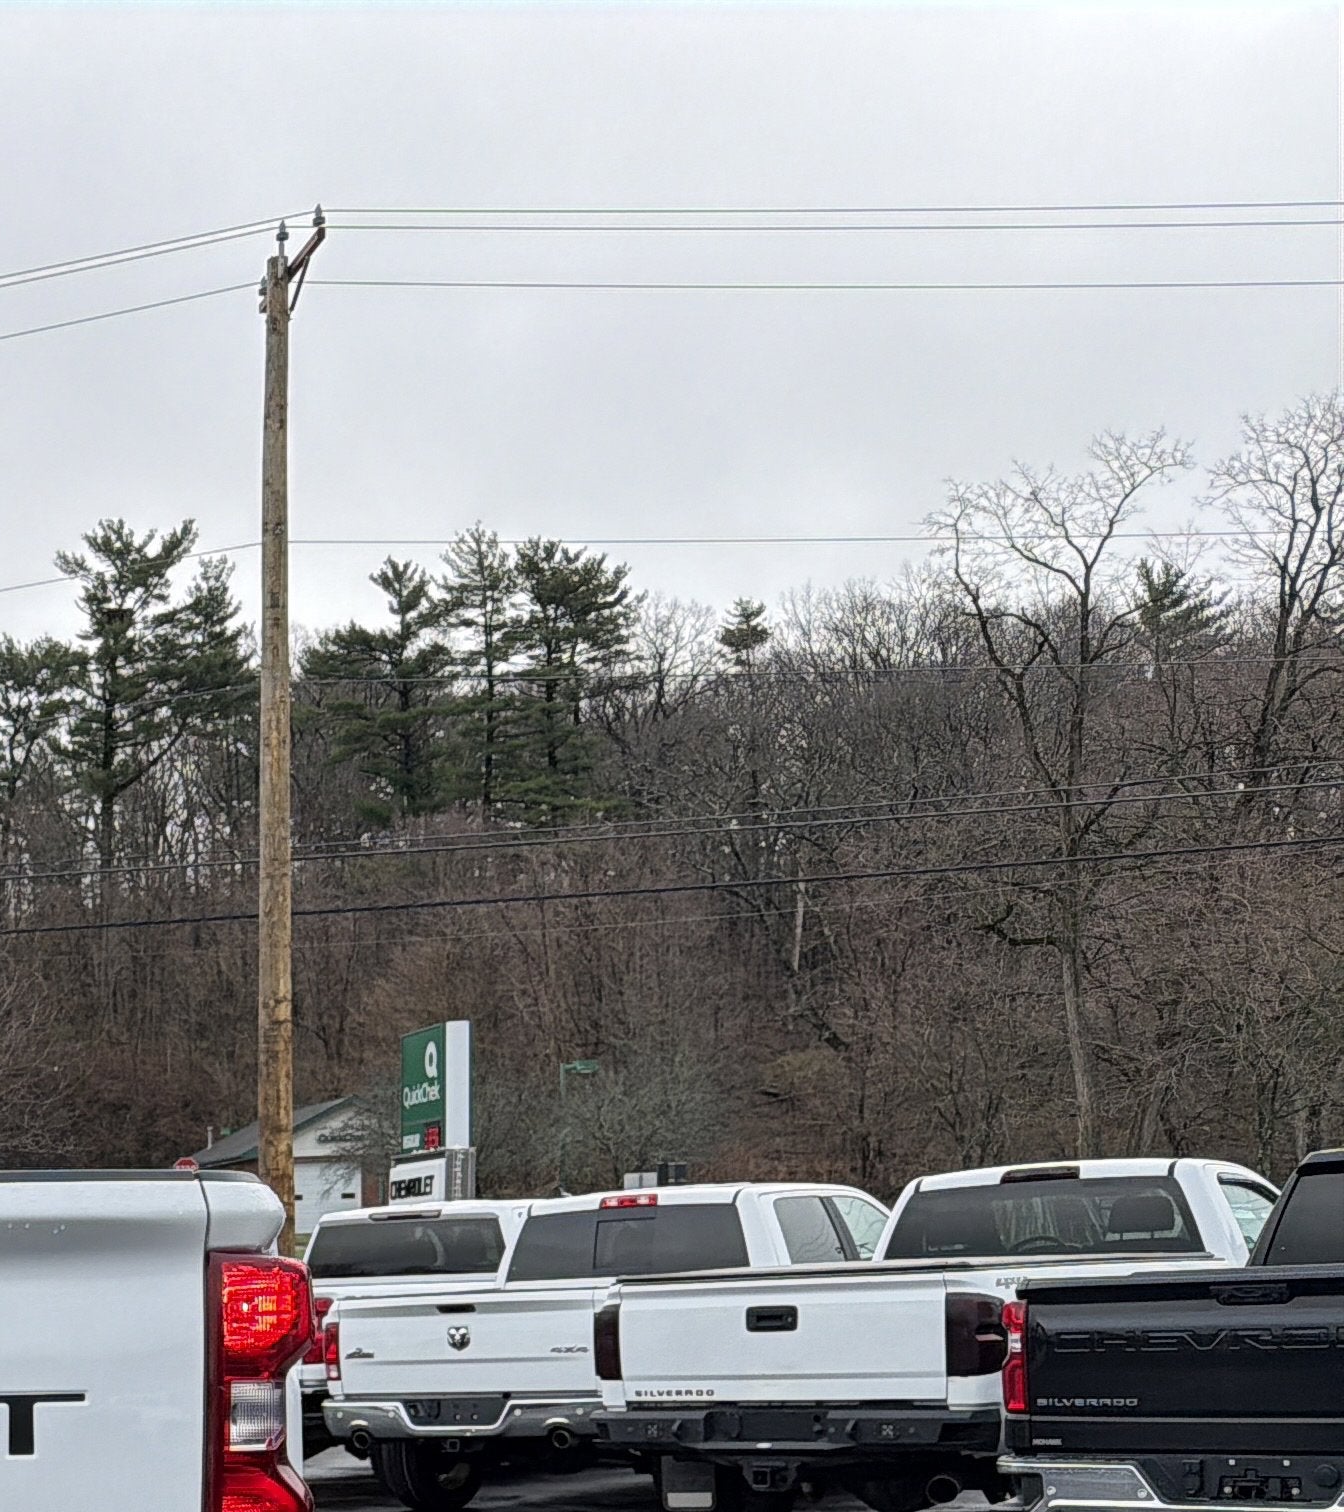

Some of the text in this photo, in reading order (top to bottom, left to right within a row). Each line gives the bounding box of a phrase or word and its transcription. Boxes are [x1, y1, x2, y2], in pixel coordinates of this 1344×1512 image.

[403, 1080, 440, 1109] QuickChek
[390, 1175, 435, 1200] CHEVROLET
[634, 1389, 715, 1398] SILVERADO
[1036, 1397, 1139, 1407] SILVERADO
